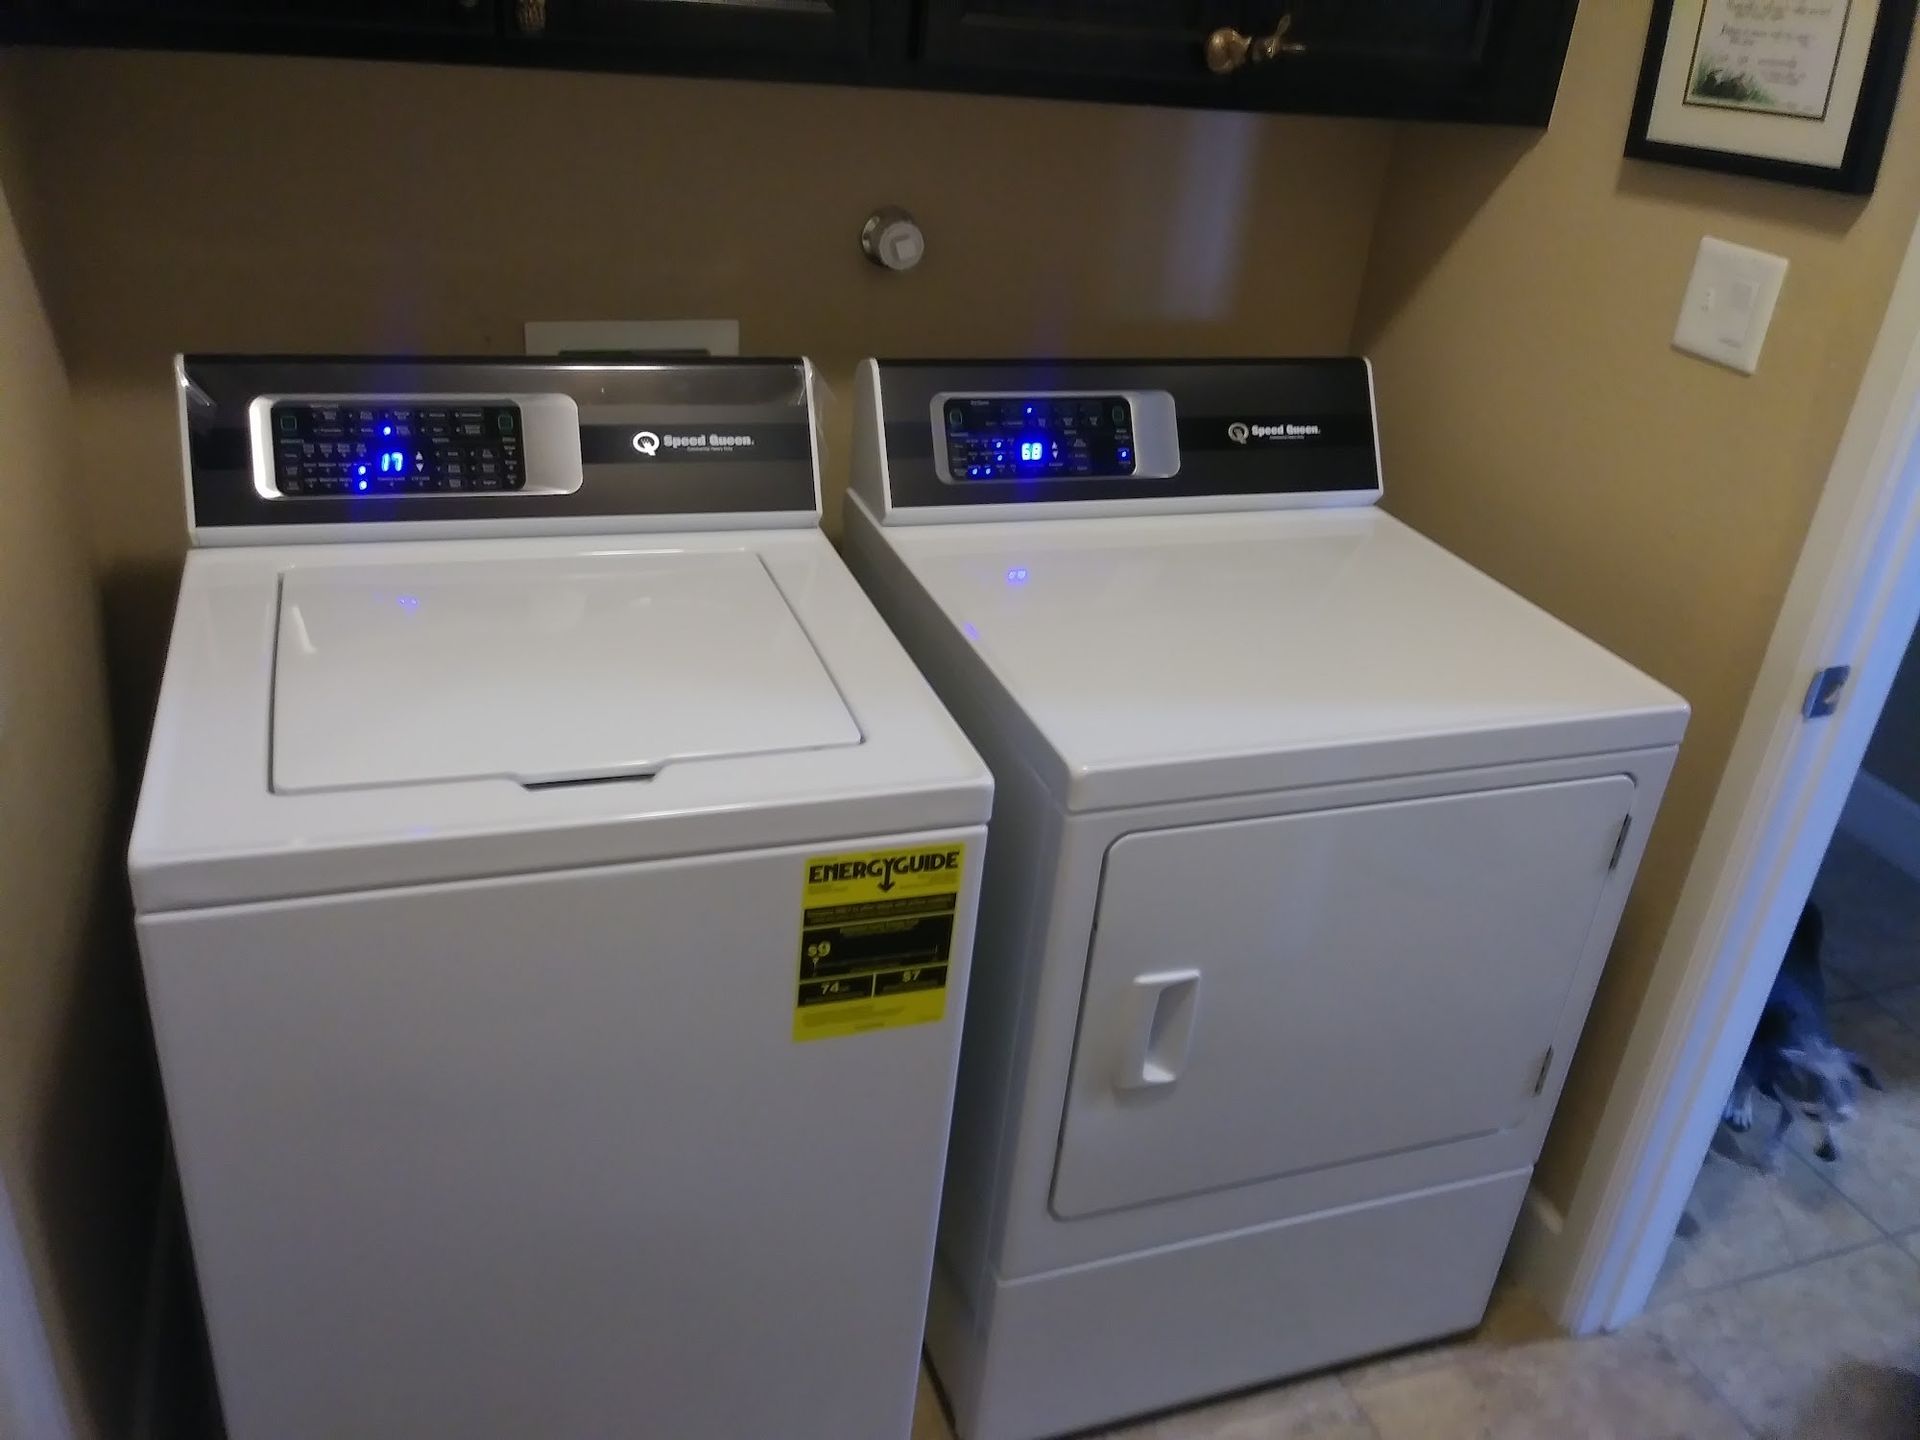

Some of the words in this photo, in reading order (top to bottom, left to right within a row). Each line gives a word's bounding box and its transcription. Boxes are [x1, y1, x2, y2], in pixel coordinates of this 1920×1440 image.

[1251, 424, 1284, 437] Speed
[1286, 424, 1319, 435] Queen
[663, 434, 706, 448] Speed
[709, 433, 751, 446] Queen
[381, 452, 403, 472] 17
[808, 850, 960, 886] ENERGYGUIDE
